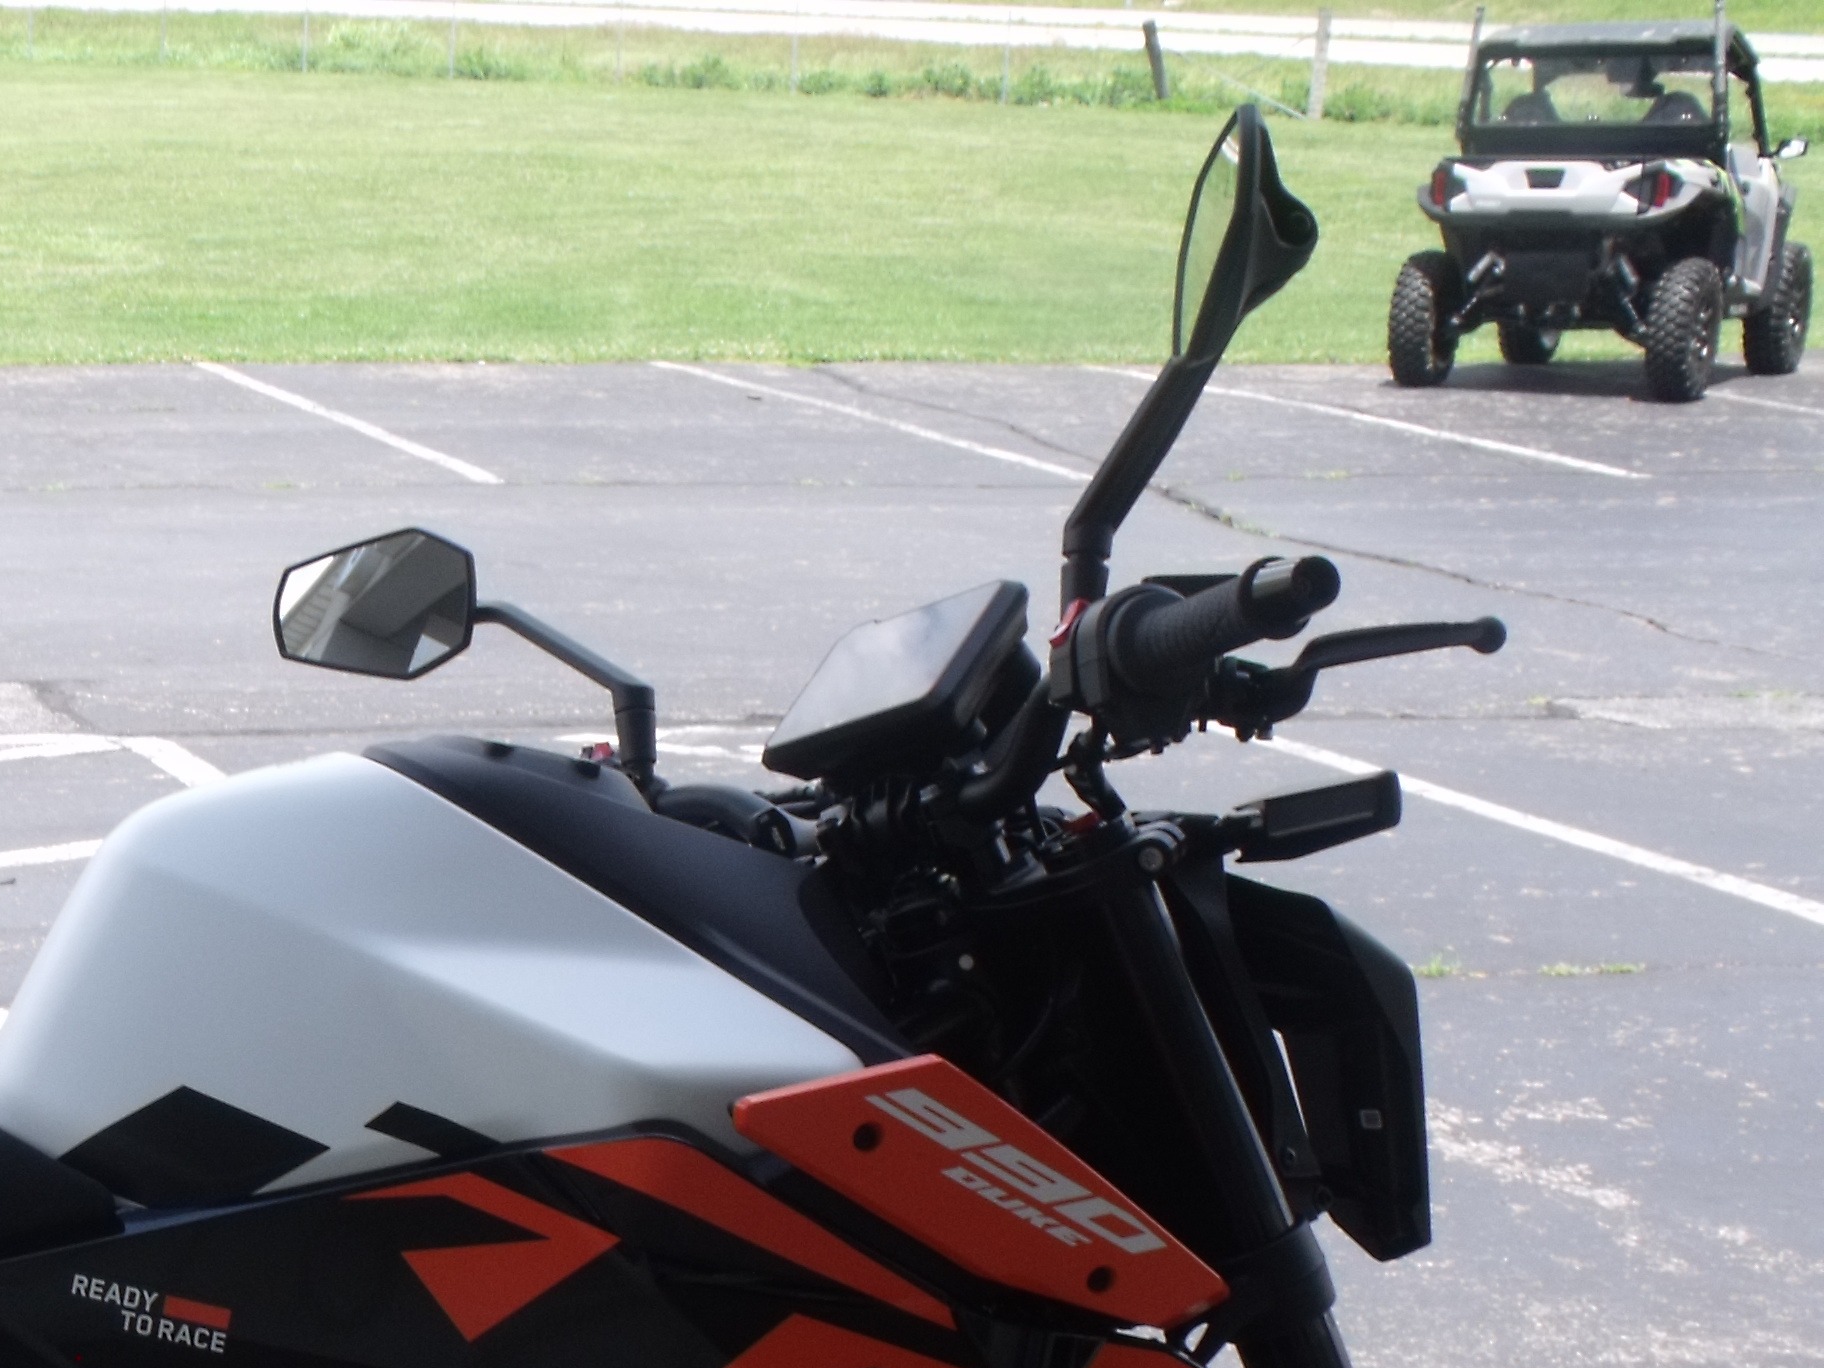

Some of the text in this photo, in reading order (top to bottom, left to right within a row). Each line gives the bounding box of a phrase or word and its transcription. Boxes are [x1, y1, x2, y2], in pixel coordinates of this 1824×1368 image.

[864, 1087, 1168, 1254] 990
[941, 1166, 1093, 1247] DUKE
[71, 1273, 159, 1313] READY
[121, 1309, 227, 1353] TO RACE
